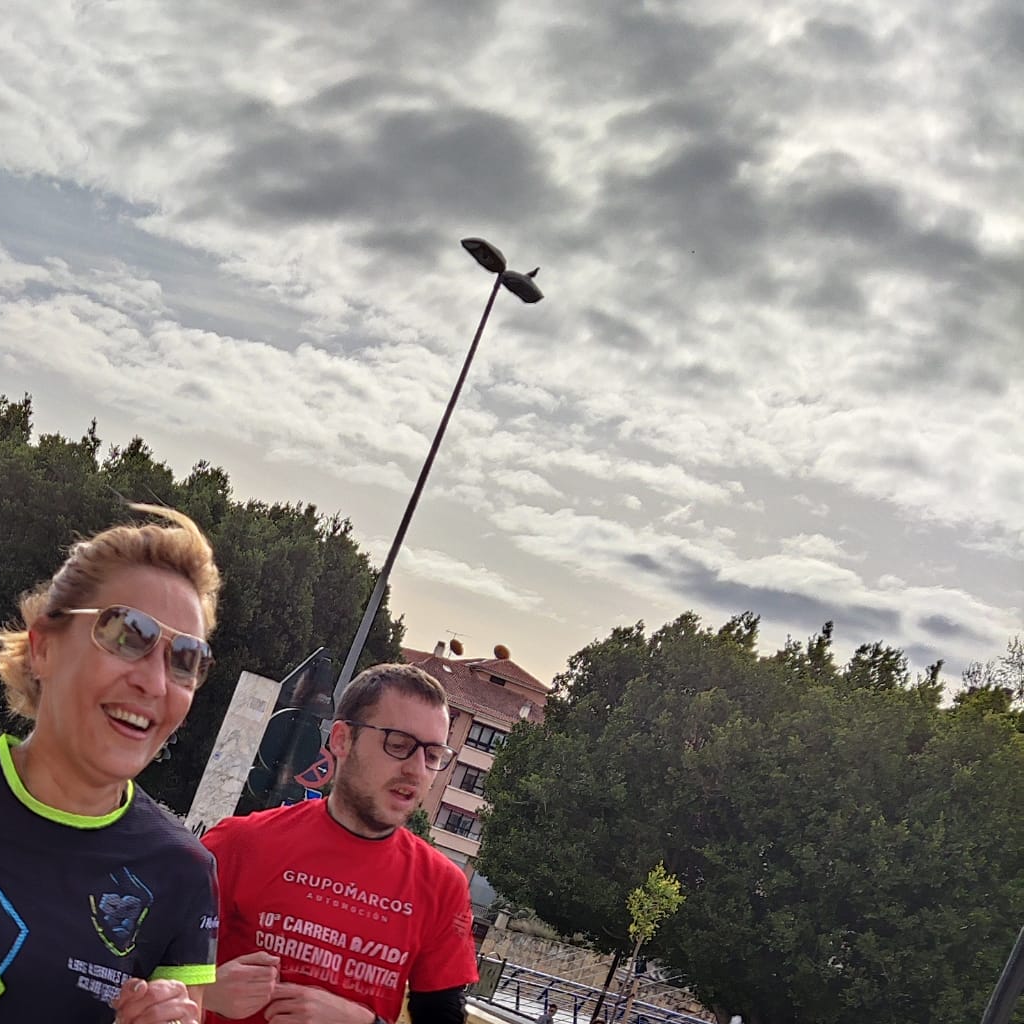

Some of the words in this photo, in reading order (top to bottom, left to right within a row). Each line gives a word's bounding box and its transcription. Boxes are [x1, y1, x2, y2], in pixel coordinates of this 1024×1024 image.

[283, 916, 347, 949] CARRERA
[256, 930, 343, 972] CORRIENDO
[344, 958, 401, 989] CONTIG
